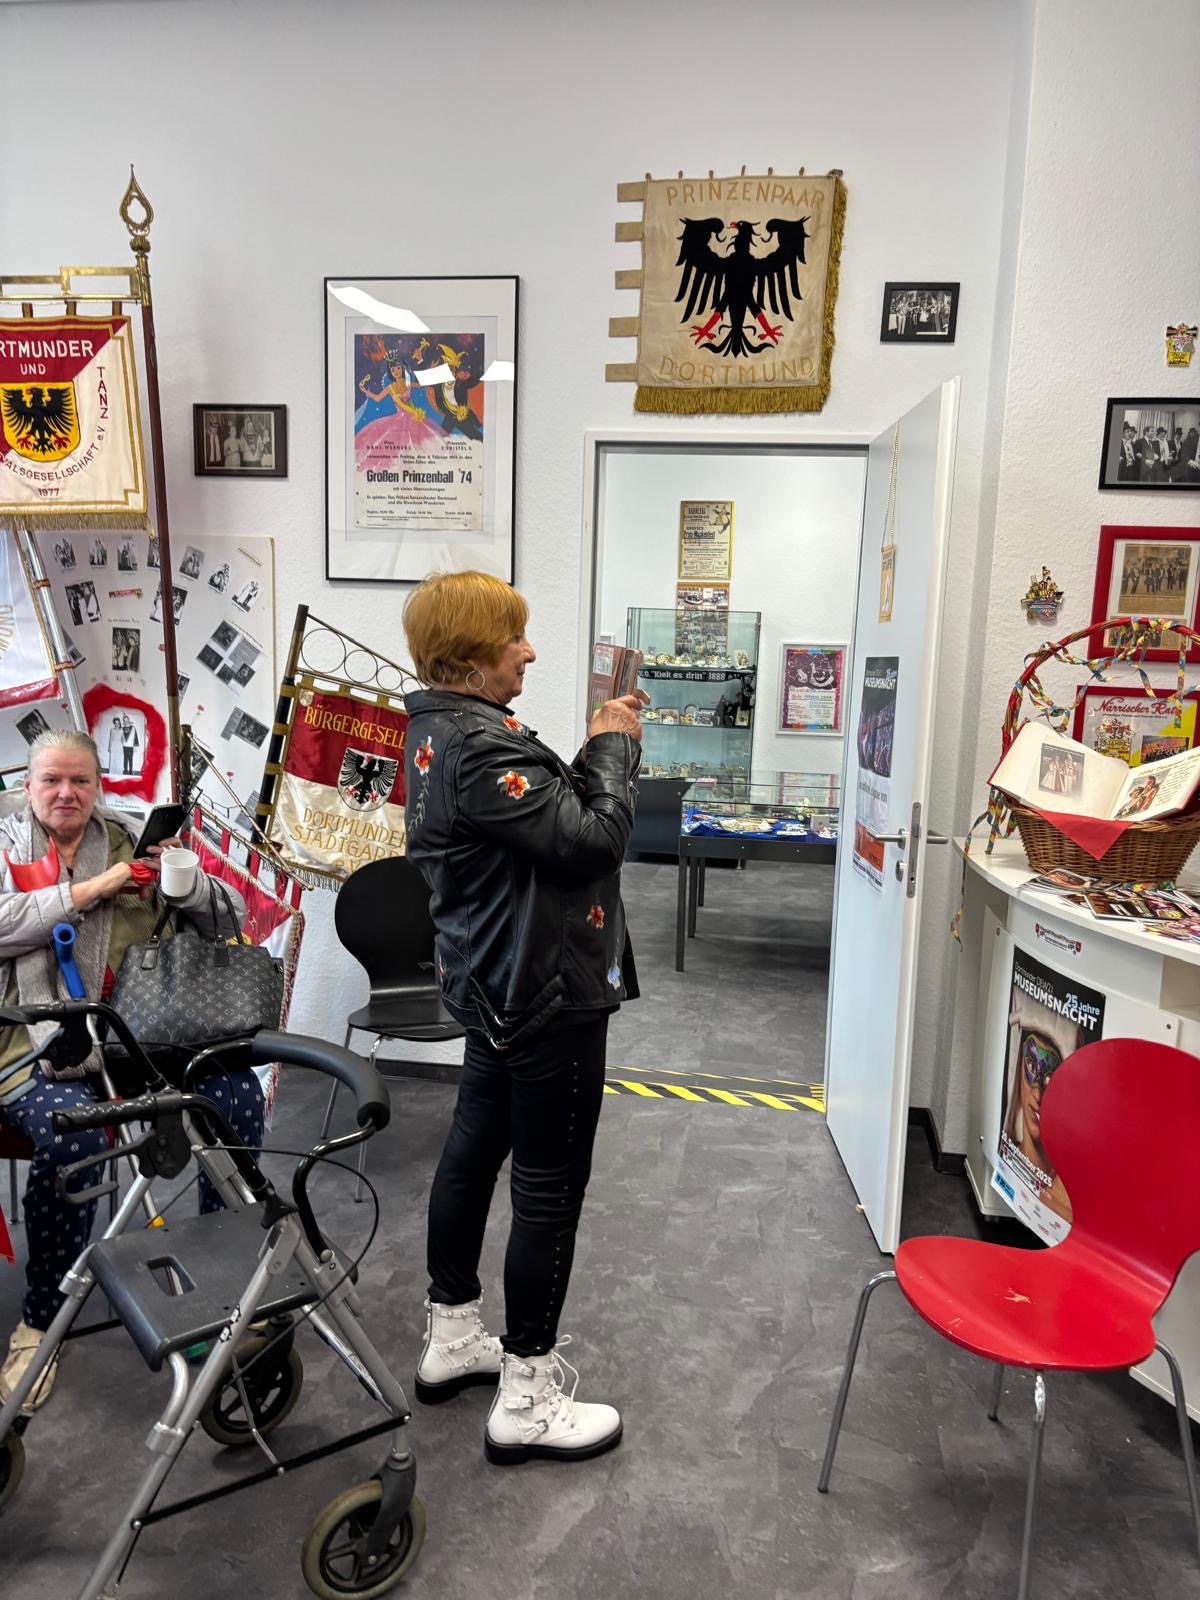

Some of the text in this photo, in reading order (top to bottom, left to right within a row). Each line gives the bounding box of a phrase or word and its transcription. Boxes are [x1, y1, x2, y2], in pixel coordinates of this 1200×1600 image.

[666, 181, 825, 210] PRINZENPAAR
[20, 363, 46, 375] UND
[659, 354, 815, 386] DORTMUND
[97, 366, 109, 419] TANZ
[366, 469, 399, 483] Großen
[402, 470, 454, 484] Prinzenball
[38, 487, 60, 497] 1977
[708, 673, 726, 681] 1888
[1094, 696, 1150, 715] Närrischer
[304, 704, 405, 750] BÜRGERGESELL
[1013, 971, 1097, 1030] MUSEUMSNACHT
[1065, 993, 1100, 1016] 25 Jahre
[1036, 1167, 1053, 1188] 2025
